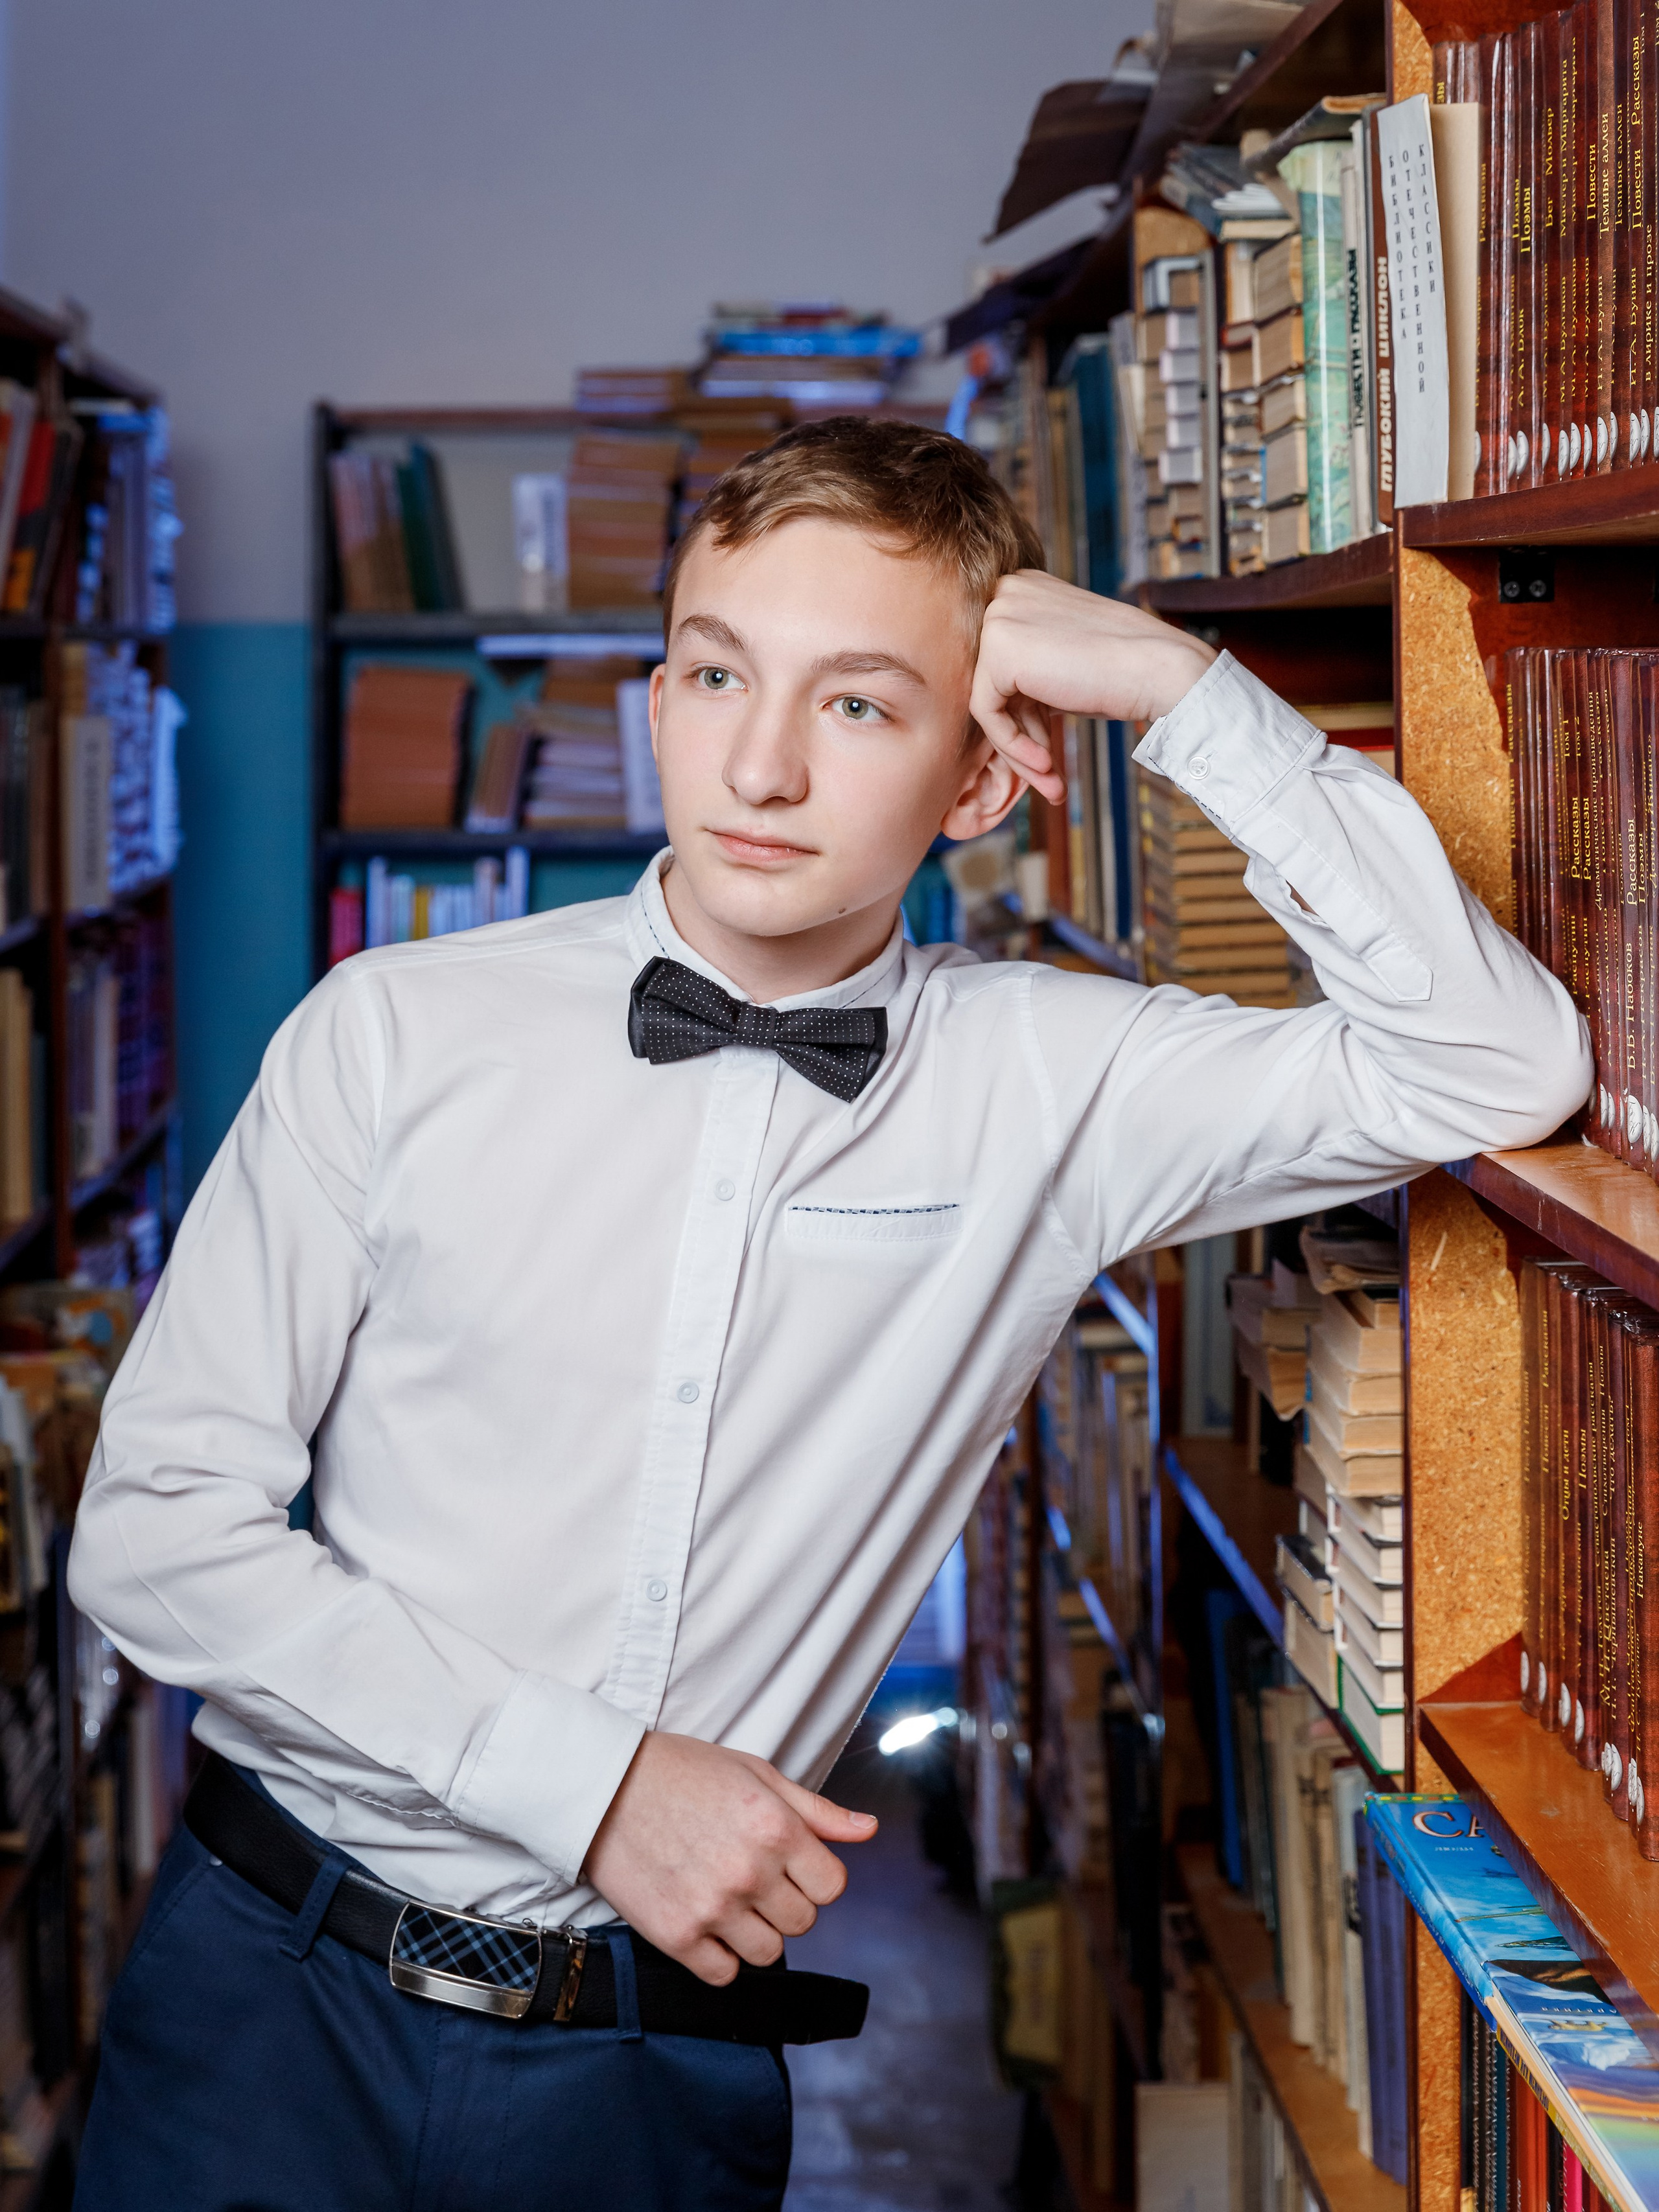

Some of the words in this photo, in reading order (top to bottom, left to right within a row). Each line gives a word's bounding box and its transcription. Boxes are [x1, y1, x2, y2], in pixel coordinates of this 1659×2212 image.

[1560, 59, 1569, 152] Маргарита
[1631, 36, 1640, 125] Рассказы
[1562, 158, 1566, 167] и
[1587, 144, 1596, 220] Повести
[1632, 150, 1642, 229] Повести
[1419, 144, 1435, 294] КЛАССИКИ
[1520, 187, 1531, 253] Поэмы
[1599, 169, 1610, 239] Темные
[1389, 155, 1407, 339] БИБЛИОТЕКА
[1402, 150, 1425, 393] ОТЕЧЕСТВЕННОЙ
[1647, 283, 1651, 293] и
[1378, 257, 1390, 357] ЦИКЛОН
[1377, 368, 1392, 492] ГЛУБОКИЙ
[1588, 692, 1597, 792] произведения
[1571, 797, 1580, 879] Рассказы
[1593, 798, 1602, 911] Драматические
[1627, 819, 1638, 906] Рассказы
[1626, 943, 1634, 1022] Набоков
[1589, 1362, 1597, 1432] рассказы
[1562, 1479, 1570, 1520] Отцы
[1578, 1429, 1586, 1489] Поэмы
